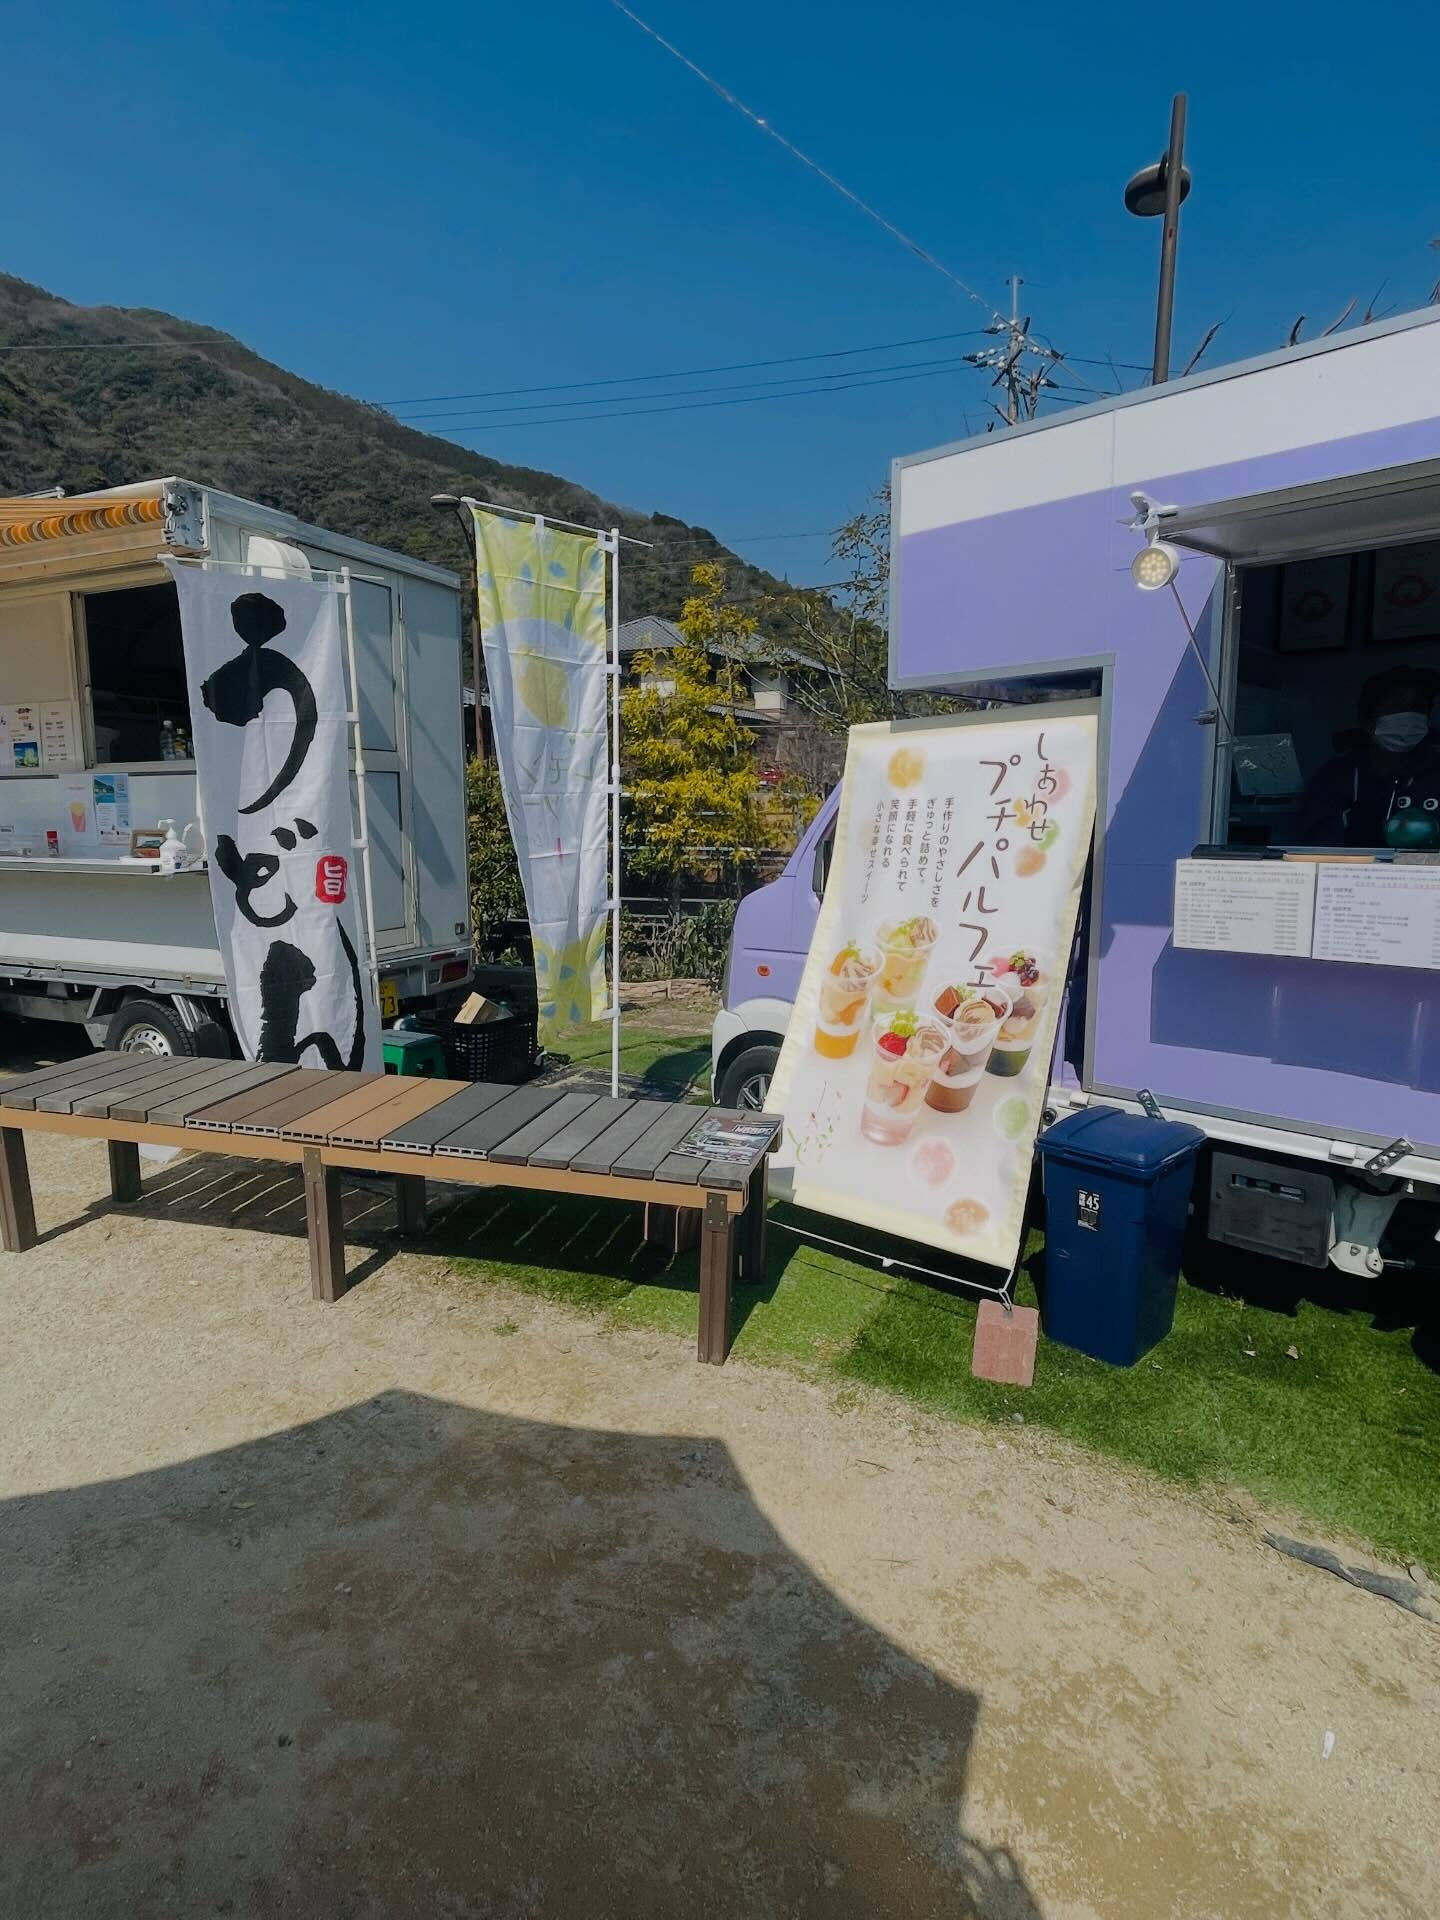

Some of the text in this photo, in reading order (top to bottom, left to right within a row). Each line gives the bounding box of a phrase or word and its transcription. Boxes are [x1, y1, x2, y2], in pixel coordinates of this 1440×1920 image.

[200, 592, 366, 1072] うどん
[881, 799, 901, 869] 笑顔になれる
[1023, 732, 1057, 841] しあわせ
[896, 798, 918, 892] 手軽に食べられて
[930, 796, 955, 908] 手作りのやさしさを
[956, 754, 1021, 988] プチパルフェ
